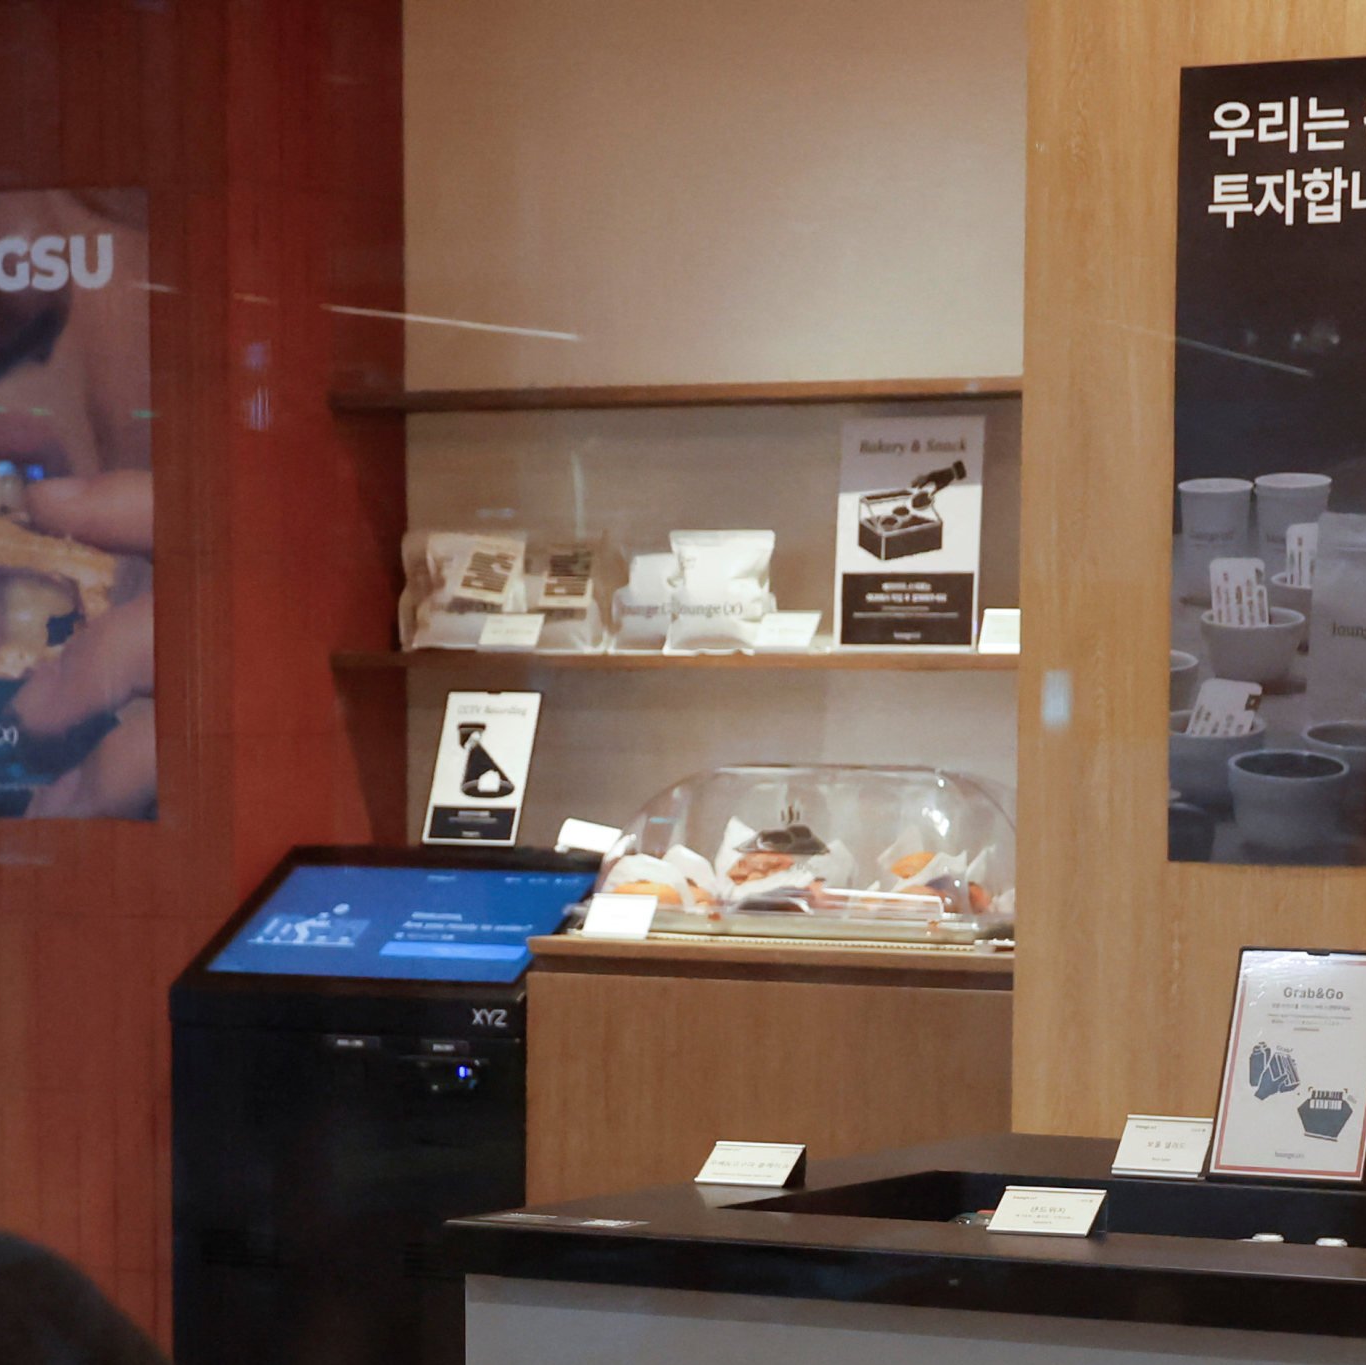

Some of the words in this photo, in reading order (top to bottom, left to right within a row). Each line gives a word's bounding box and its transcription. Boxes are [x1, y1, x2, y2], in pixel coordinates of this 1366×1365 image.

[1208, 96, 1349, 157] 우리는
[1283, 986, 1344, 1000] Grab&Go
[472, 1008, 508, 1027] XYZ
